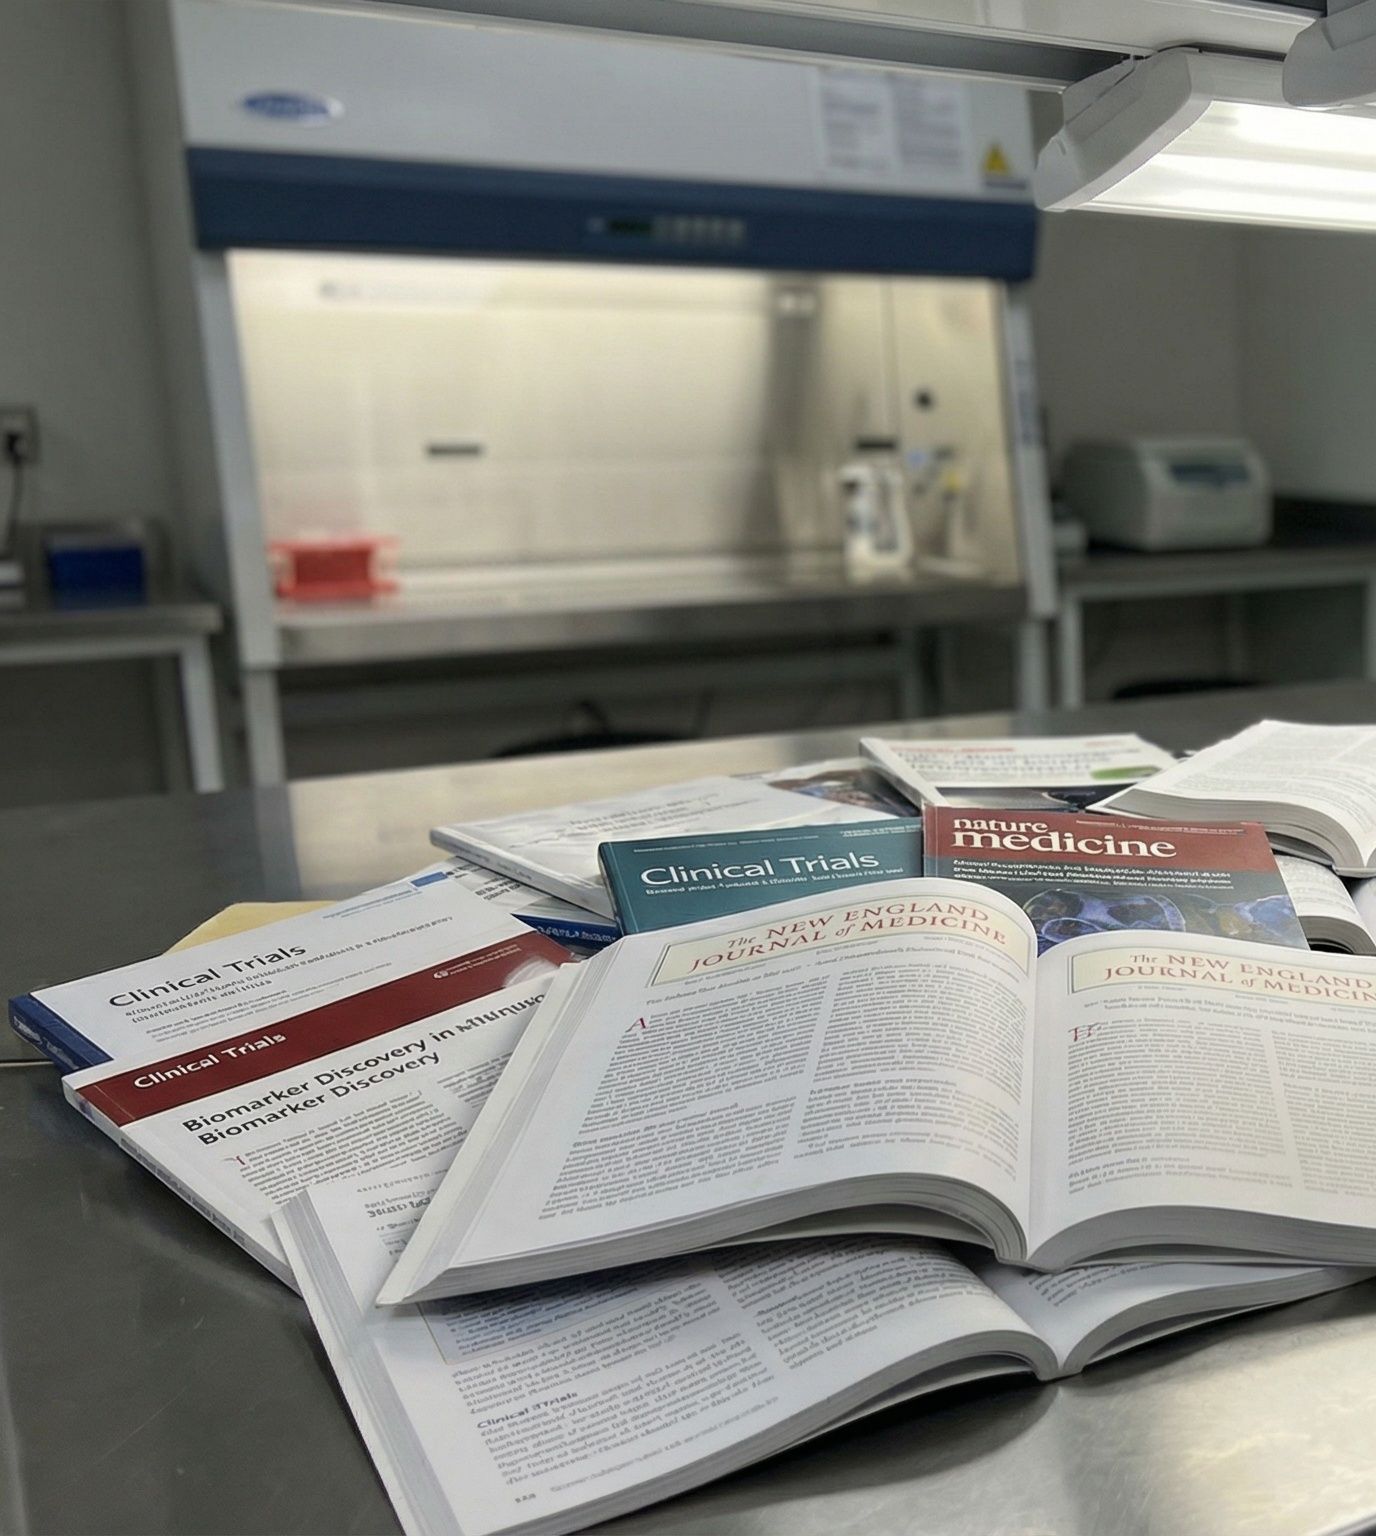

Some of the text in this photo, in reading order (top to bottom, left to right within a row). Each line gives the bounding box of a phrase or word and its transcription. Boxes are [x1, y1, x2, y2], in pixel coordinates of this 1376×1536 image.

[951, 830, 1178, 858] medicine
[953, 818, 1049, 834] nature
[640, 858, 775, 886] Clinical
[778, 851, 880, 875] Trials
[688, 914, 1007, 974] JOURNAL of MEDICINE
[726, 901, 989, 950] The NEW ENGLAND
[108, 966, 222, 1008] Clinical
[223, 943, 307, 975] Trials
[1102, 966, 1234, 984] JOURNAL
[1240, 975, 1258, 989] of
[1129, 953, 1373, 991] The NEW ENGLAND
[221, 1031, 288, 1059] Trials
[181, 1027, 456, 1134] Biomarker Discovery in
[197, 1050, 442, 1147] Biomarker Discovery
